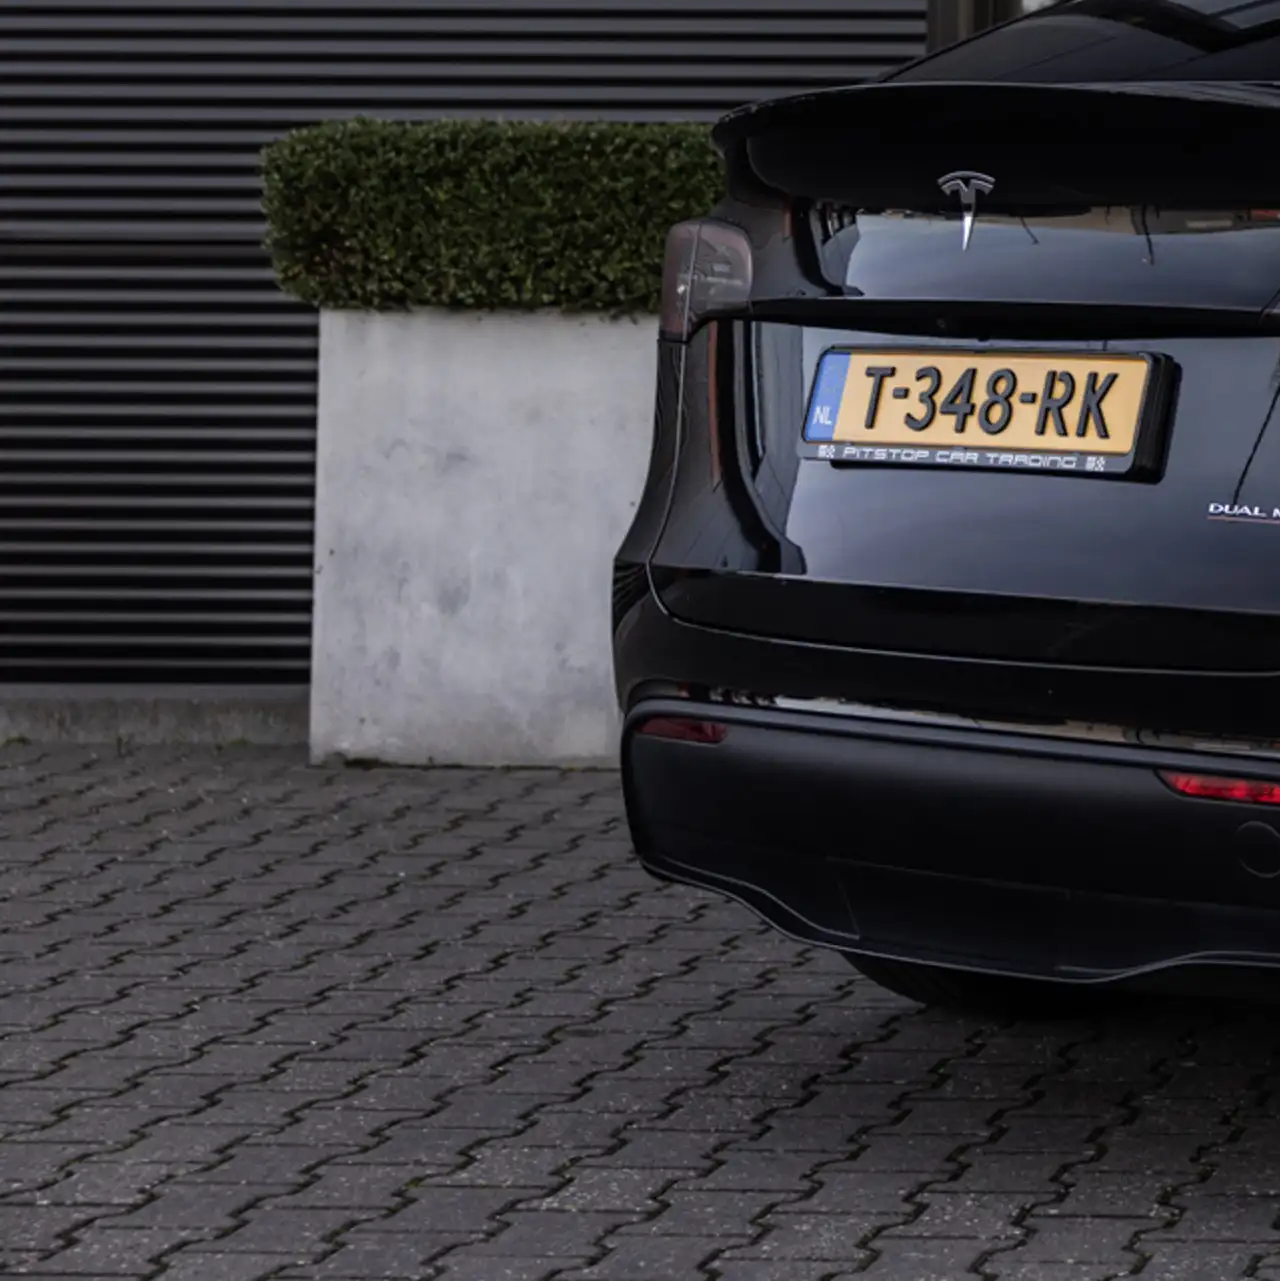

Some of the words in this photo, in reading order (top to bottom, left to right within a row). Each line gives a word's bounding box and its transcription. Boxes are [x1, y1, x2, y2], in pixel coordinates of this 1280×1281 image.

[864, 366, 1119, 439] T-348-RK
[812, 405, 833, 425] NL
[842, 445, 930, 462] PITSTOP
[935, 450, 979, 465] CAR
[985, 452, 1078, 468] TRADING
[1208, 502, 1267, 517] DUAL
